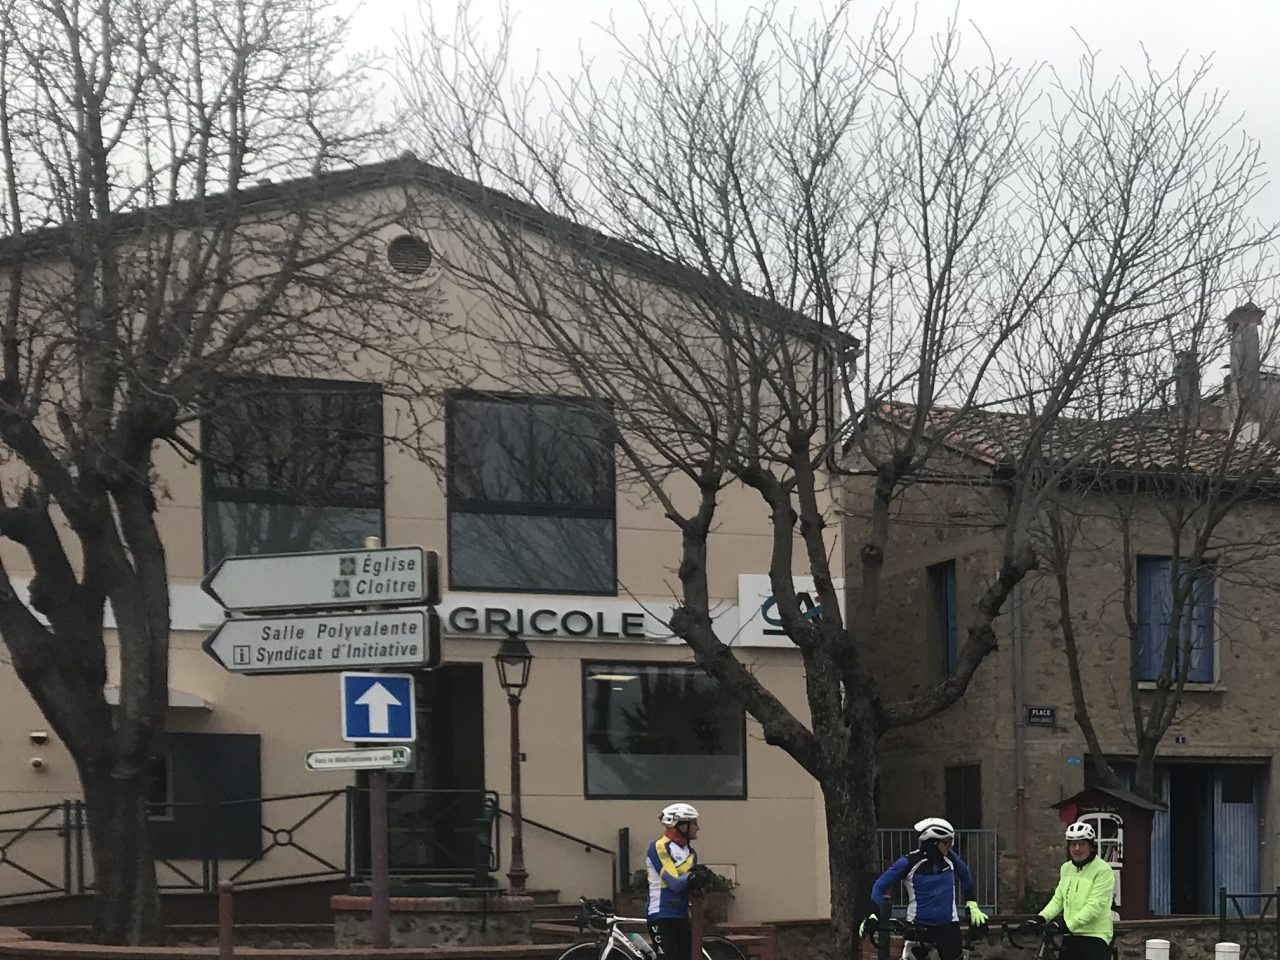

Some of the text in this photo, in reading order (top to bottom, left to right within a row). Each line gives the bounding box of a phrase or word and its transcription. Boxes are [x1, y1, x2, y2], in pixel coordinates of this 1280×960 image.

[362, 553, 416, 576] Église
[356, 579, 417, 595] Cloître
[261, 621, 418, 641] Salle Polyvalente
[443, 606, 645, 637] GRICOLE
[256, 647, 323, 665] Syndicat
[331, 643, 418, 660] d'Initiative
